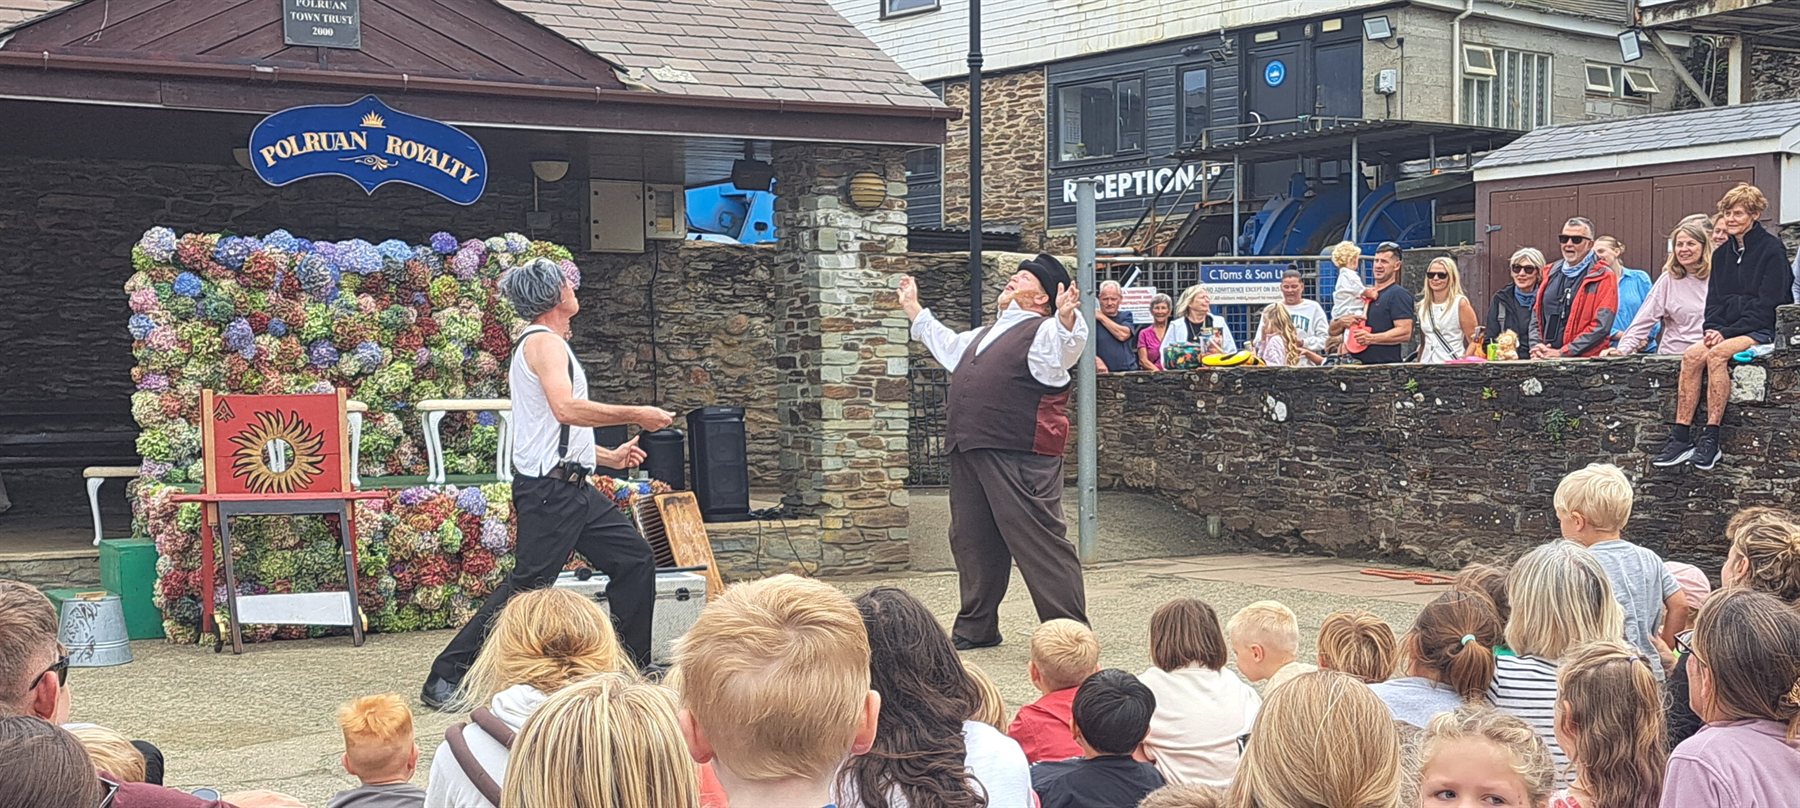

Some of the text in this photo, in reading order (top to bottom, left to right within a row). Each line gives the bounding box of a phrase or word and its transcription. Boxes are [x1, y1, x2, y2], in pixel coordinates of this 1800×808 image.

[296, 0, 348, 10] POLRUAN
[290, 11, 354, 25] TOWN TRUST
[312, 26, 334, 37] 2000
[259, 131, 480, 185] POLRUAN ROYALTY
[1063, 165, 1195, 203] RCEPTION
[1245, 269, 1253, 280] &
[1255, 269, 1273, 280] Son
